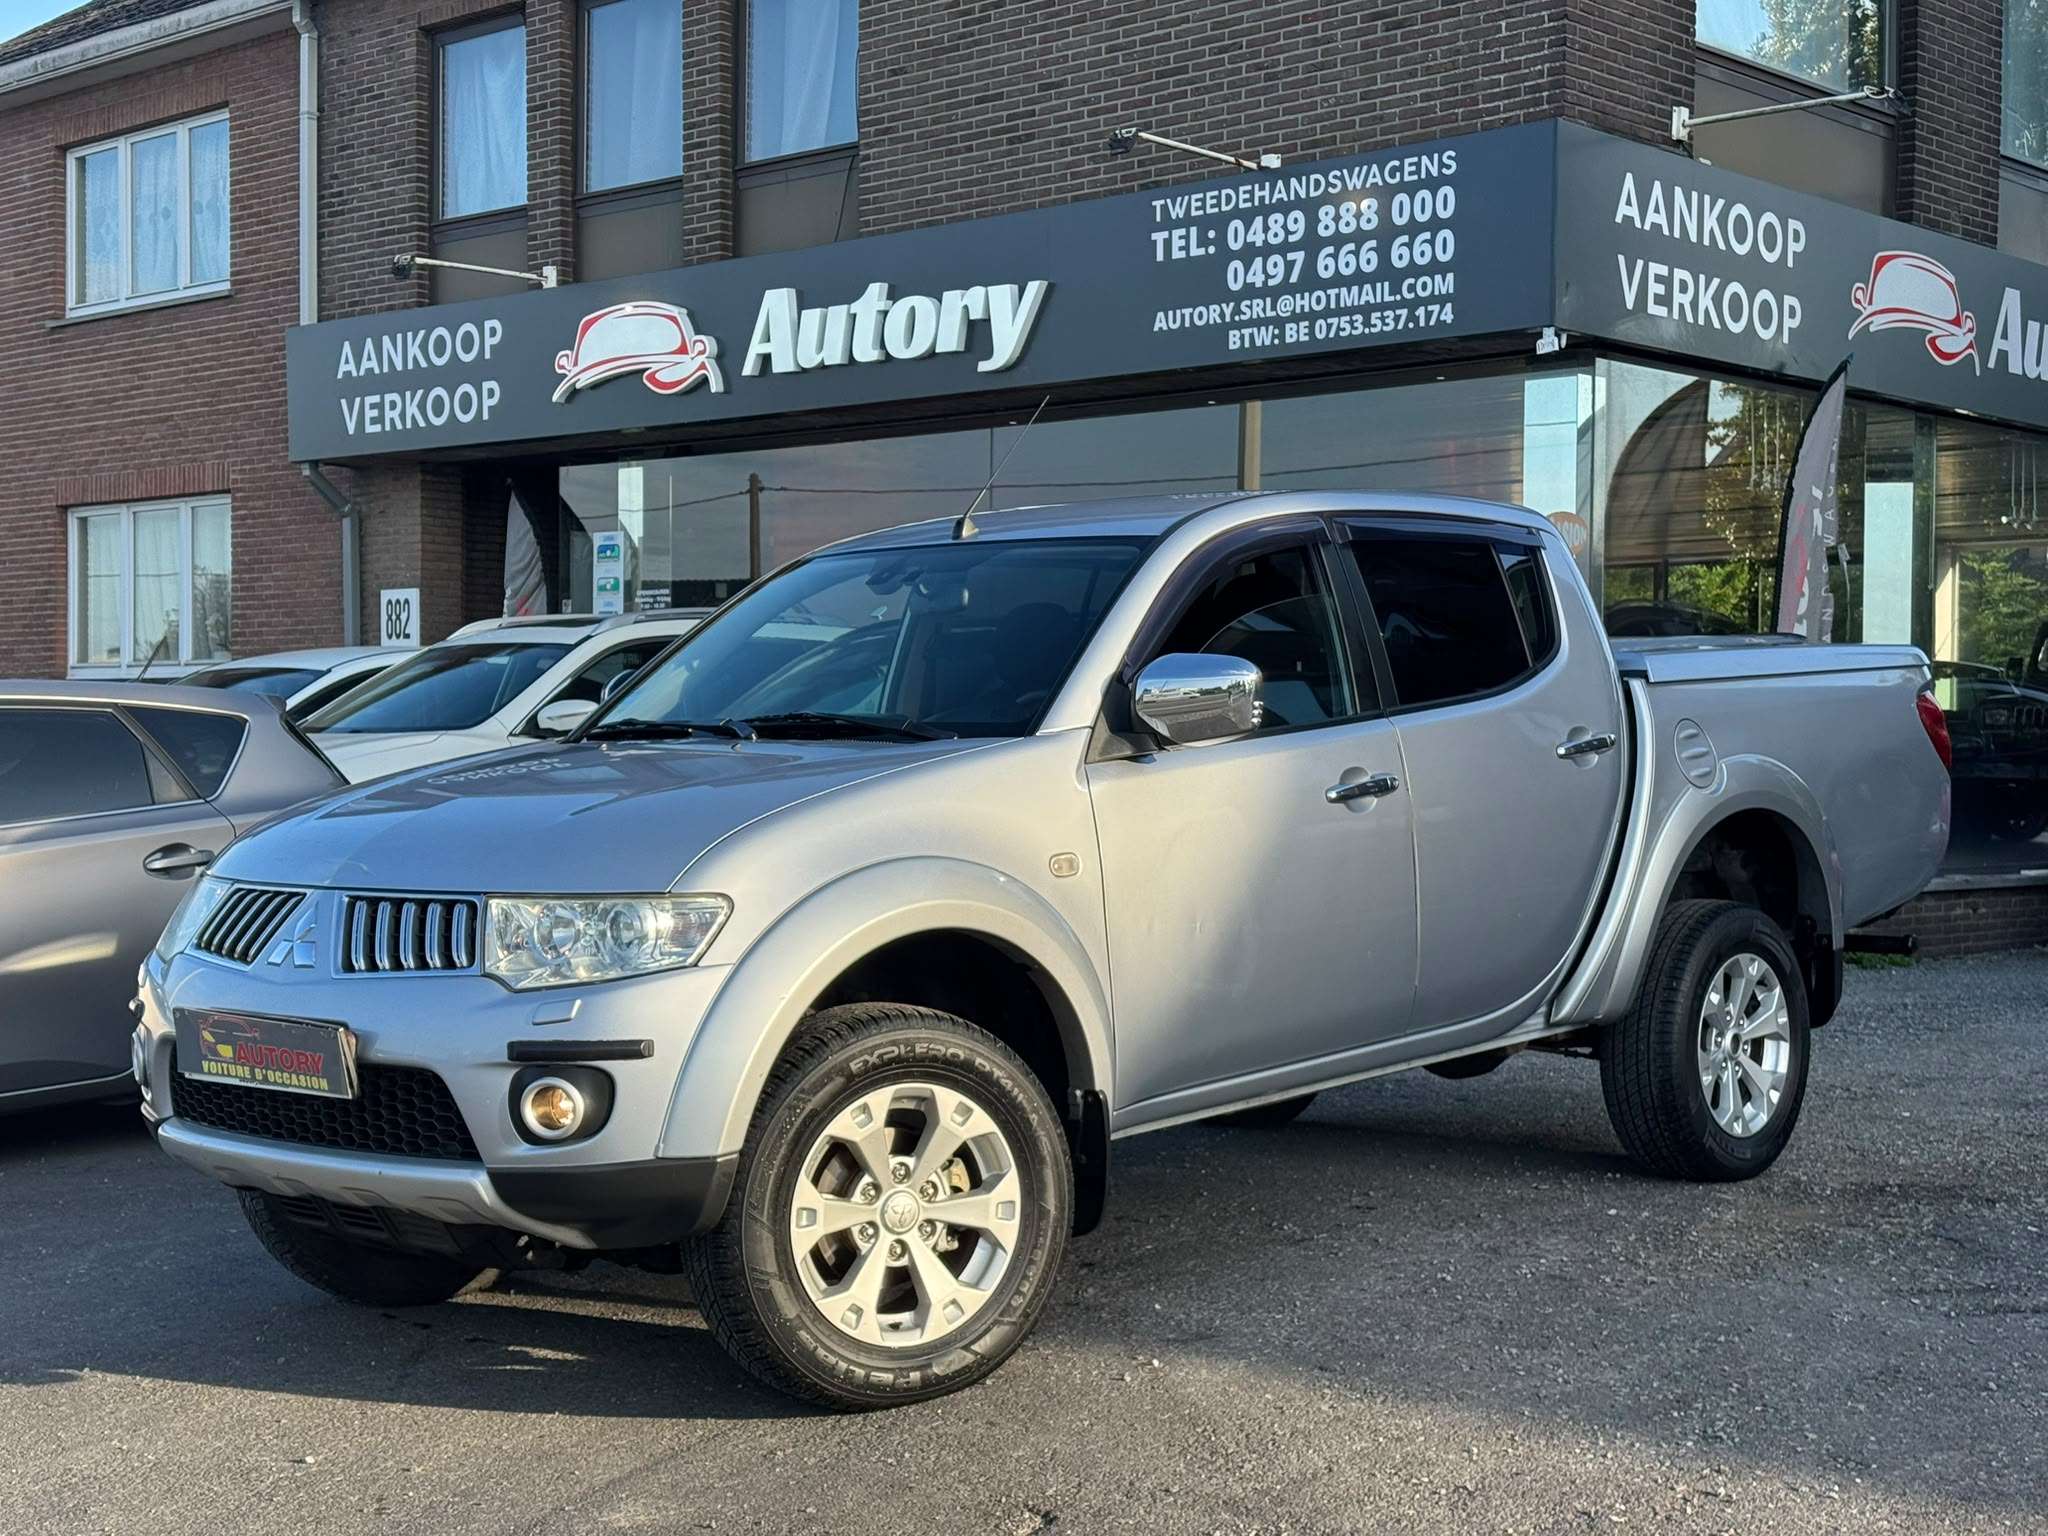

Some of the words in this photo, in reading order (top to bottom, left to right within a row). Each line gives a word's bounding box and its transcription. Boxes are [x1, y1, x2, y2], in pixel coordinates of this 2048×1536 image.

[1151, 150, 1458, 223] TWEEDEHANDSWAGENS
[1151, 226, 1216, 262] TEL:
[1227, 209, 1306, 251] 0489
[1317, 197, 1380, 238] 888
[1391, 185, 1456, 226] 000
[1614, 172, 1807, 269] AANKOOP
[1227, 251, 1306, 291] 0497
[1317, 239, 1378, 279] 666
[1391, 229, 1455, 270] 660
[741, 280, 1049, 377] Autory
[1153, 272, 1455, 332] AUTORY.SRL@HOTMAIL.COM
[1228, 325, 1280, 350] BTW:
[1285, 320, 1310, 344] BE
[1315, 303, 1454, 339] 0753.537.174
[1617, 253, 1802, 344] VERKOOP
[336, 319, 503, 380] AANKOOP
[340, 379, 501, 436] VERKOOP
[385, 598, 411, 640] 882
[202, 1060, 251, 1078] VOITURE
[254, 1067, 329, 1091] D'OCCASION
[235, 1041, 324, 1075] AUTORY
